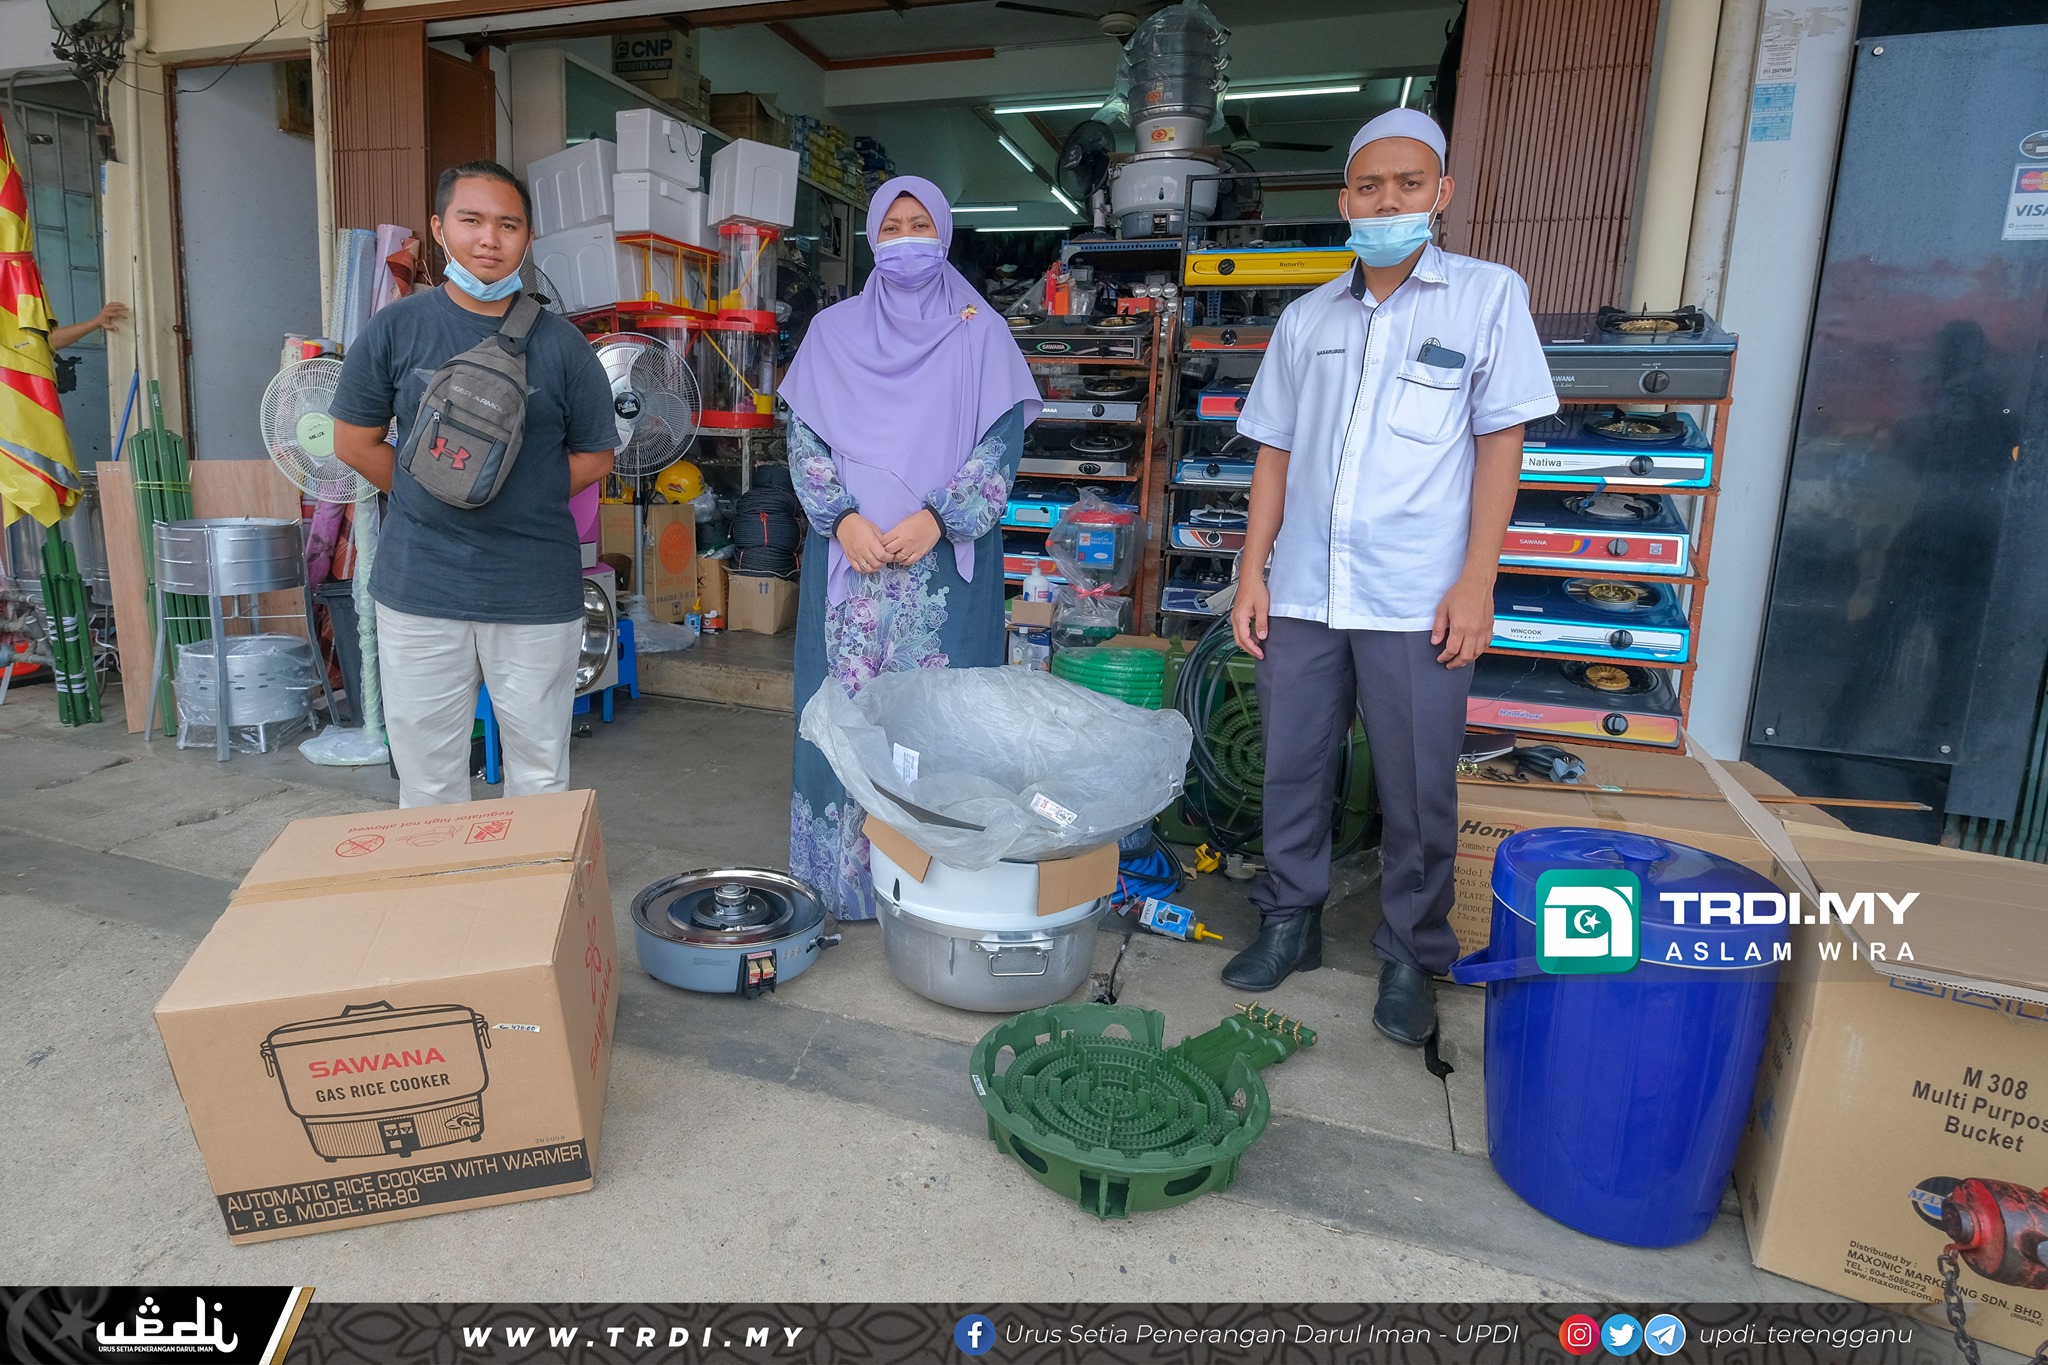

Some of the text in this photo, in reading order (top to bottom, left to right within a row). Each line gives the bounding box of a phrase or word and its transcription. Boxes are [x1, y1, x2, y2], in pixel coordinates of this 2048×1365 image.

[631, 38, 673, 58] CNP
[618, 60, 670, 71] BOOSTER PUMP
[1041, 343, 1066, 351] SAWANA
[1528, 458, 1562, 467] Natiwa
[1519, 538, 1547, 546] SAWANA
[1498, 708, 1542, 720] Homelux
[348, 823, 398, 834] allowed
[454, 810, 515, 822] Regulator
[1456, 840, 1497, 853] Commerc
[1460, 879, 1476, 887] GAS
[308, 1047, 446, 1078] SAWANA
[315, 1073, 450, 1102] GAS RICE COOKER
[1962, 1066, 2029, 1100] M 308
[1911, 1080, 2048, 1134] Multi Purpos
[1944, 1114, 2024, 1153] Bucket
[227, 1144, 583, 1213] AUTOMATIC RICE COOKER WITH WARMER
[231, 1187, 420, 1231] L. P. G. MODEL: RR-80
[1850, 1240, 1898, 1262] Distributed
[1900, 1256, 1912, 1268] by
[1843, 1268, 1943, 1305] www.maxonic.com.m
[1845, 1259, 1863, 1271] TEL
[1869, 1267, 1927, 1292] 604-5086272
[1847, 1249, 2044, 1321] MAXONIC MARKEING SDN. BHD.
